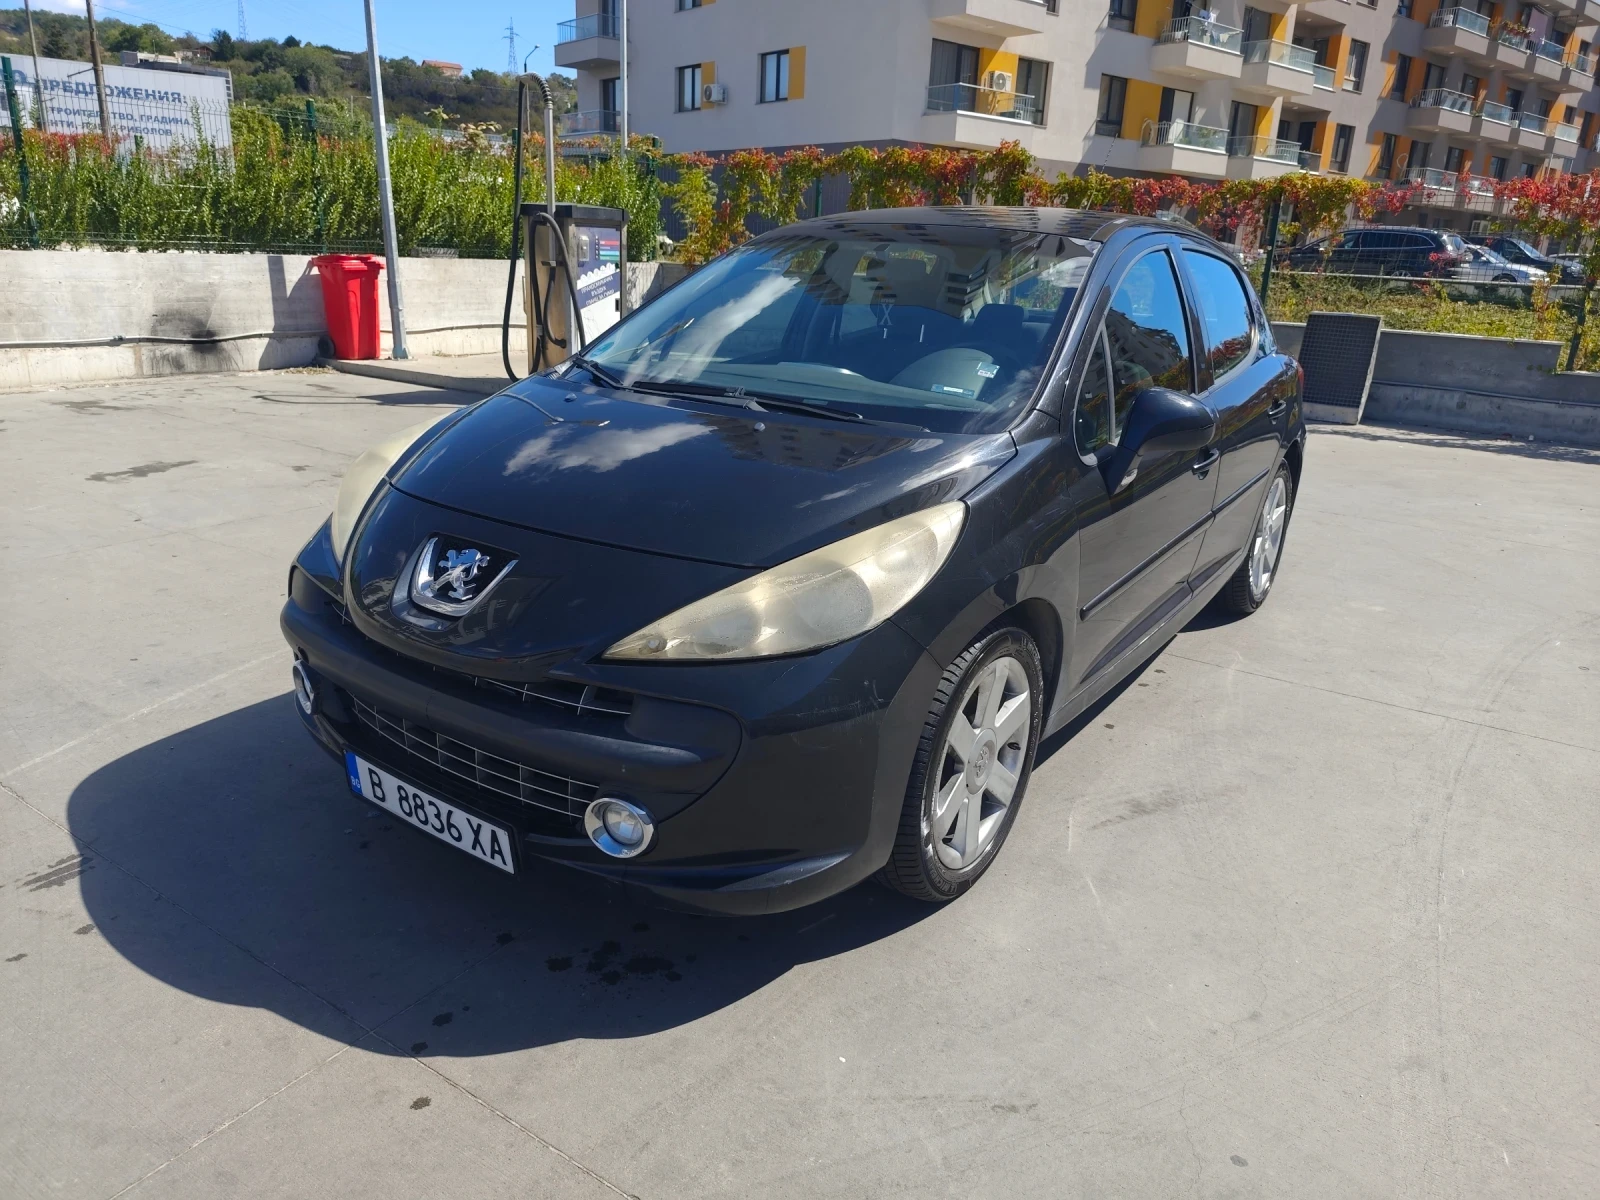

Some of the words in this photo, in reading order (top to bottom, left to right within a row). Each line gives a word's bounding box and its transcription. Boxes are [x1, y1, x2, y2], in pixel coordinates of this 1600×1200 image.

[350, 775, 361, 789] BG
[367, 767, 386, 802] B
[397, 784, 463, 843] 8836
[466, 817, 508, 866] XA
